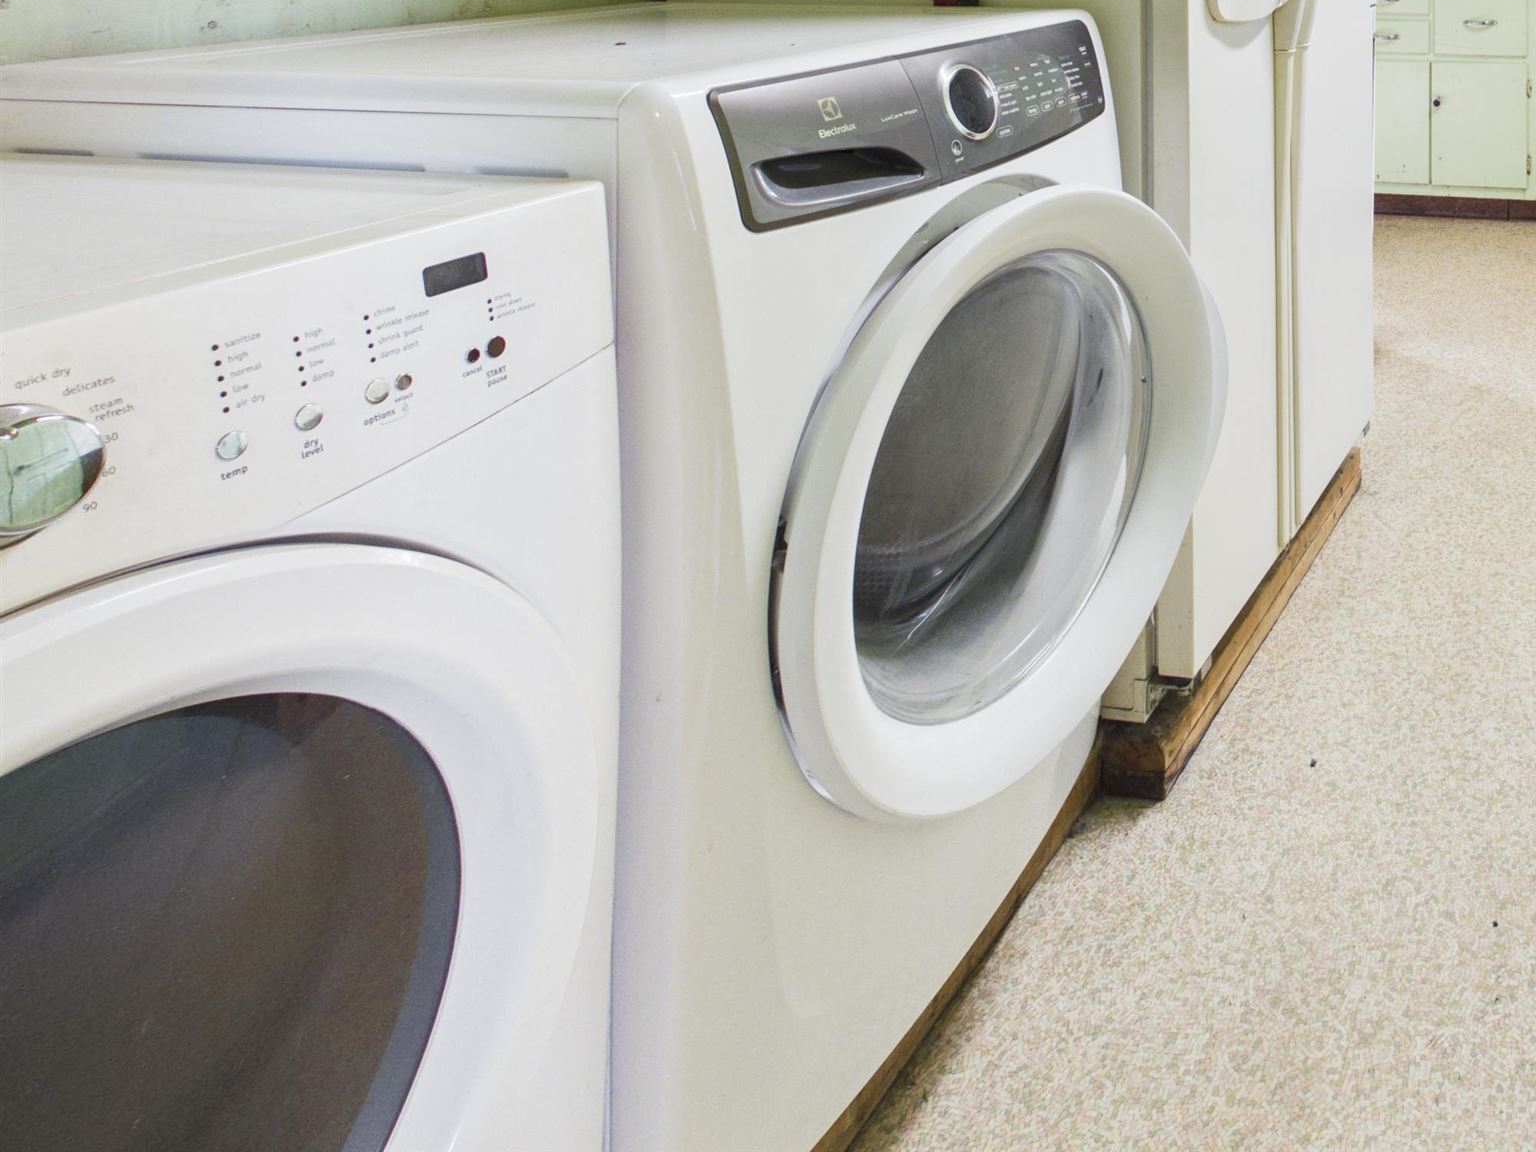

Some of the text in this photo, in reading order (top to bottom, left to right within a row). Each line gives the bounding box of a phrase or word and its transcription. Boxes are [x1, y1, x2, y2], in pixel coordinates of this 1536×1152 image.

[818, 123, 857, 139] Electrolux
[224, 332, 262, 348] sanitize
[227, 350, 249, 363] high
[230, 362, 263, 378] normal
[486, 365, 507, 378] START
[15, 367, 72, 390] quick dry
[62, 375, 116, 397] delicates
[488, 375, 507, 388] pause
[232, 382, 250, 393] low
[89, 398, 124, 413] steam
[236, 393, 266, 408] air dry
[95, 404, 135, 421] refresh
[363, 409, 396, 426] options
[104, 432, 119, 445] 30
[304, 438, 319, 449] dry
[301, 444, 325, 459] level
[221, 465, 248, 481] temp
[82, 501, 99, 513] 90
